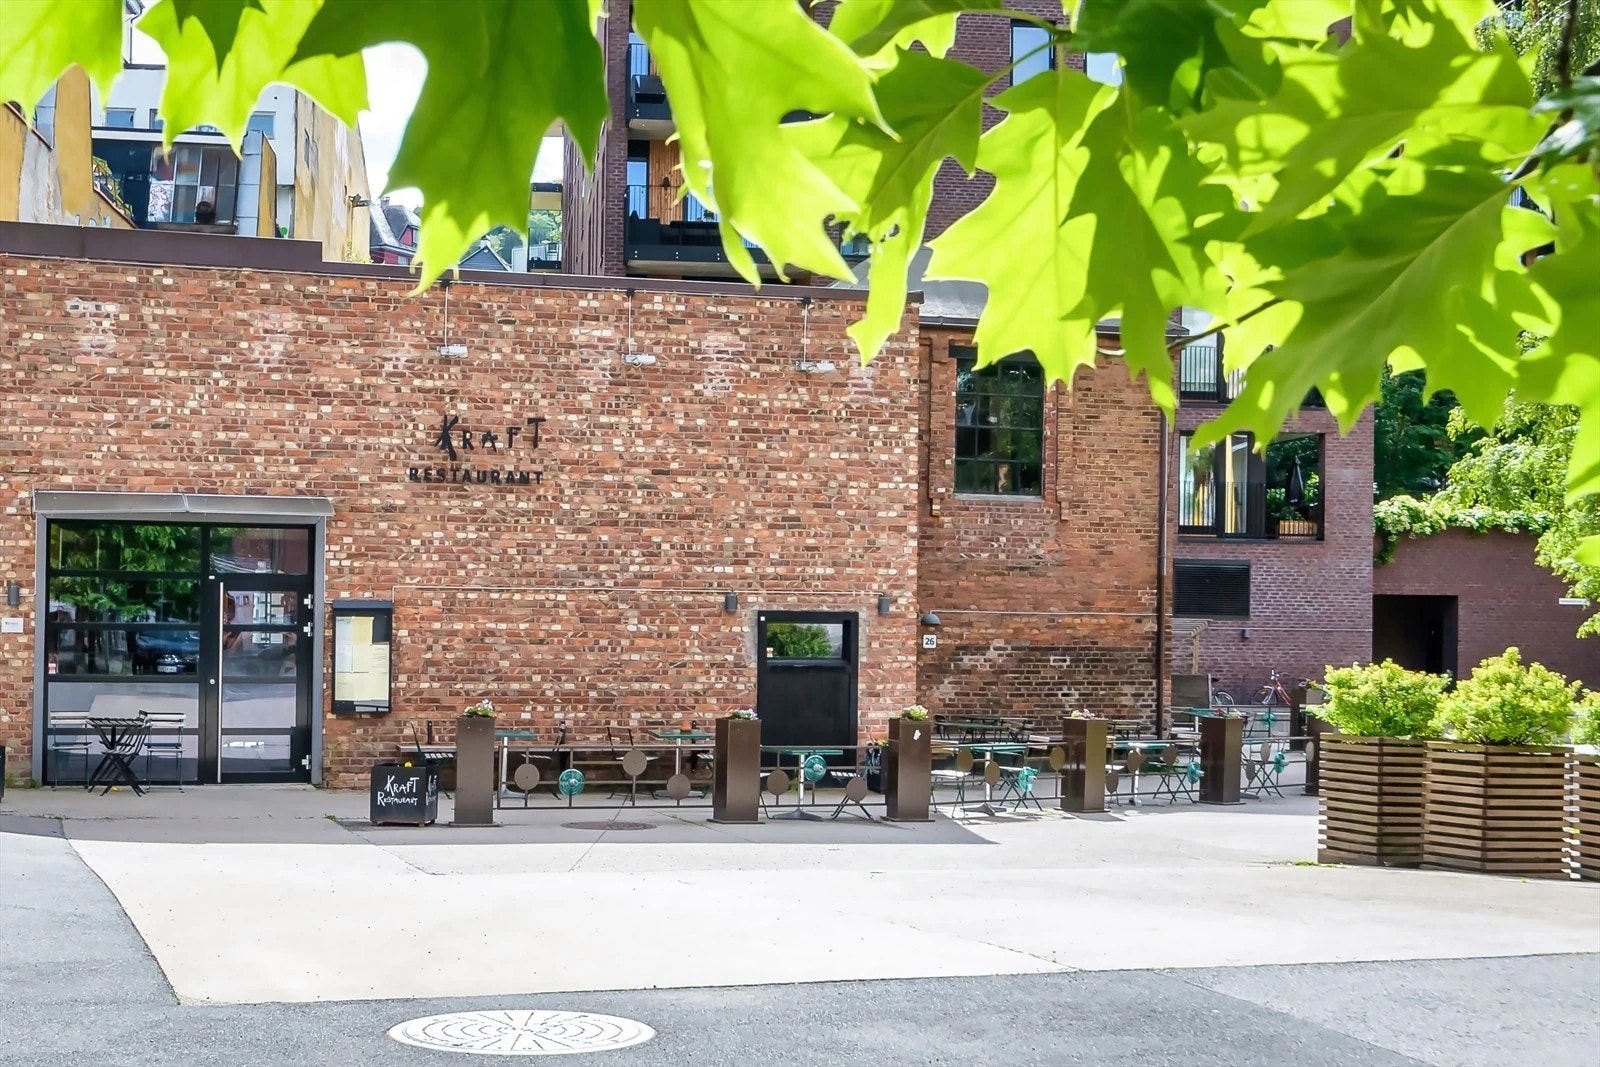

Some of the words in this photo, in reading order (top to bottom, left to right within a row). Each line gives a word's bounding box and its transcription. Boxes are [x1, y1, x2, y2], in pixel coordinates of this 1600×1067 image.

[435, 414, 547, 461] KRAFT
[409, 466, 543, 485] RESTAURANT
[925, 637, 935, 645] 26
[384, 775, 420, 796] KRAFT
[377, 791, 418, 806] RESTAURANT
